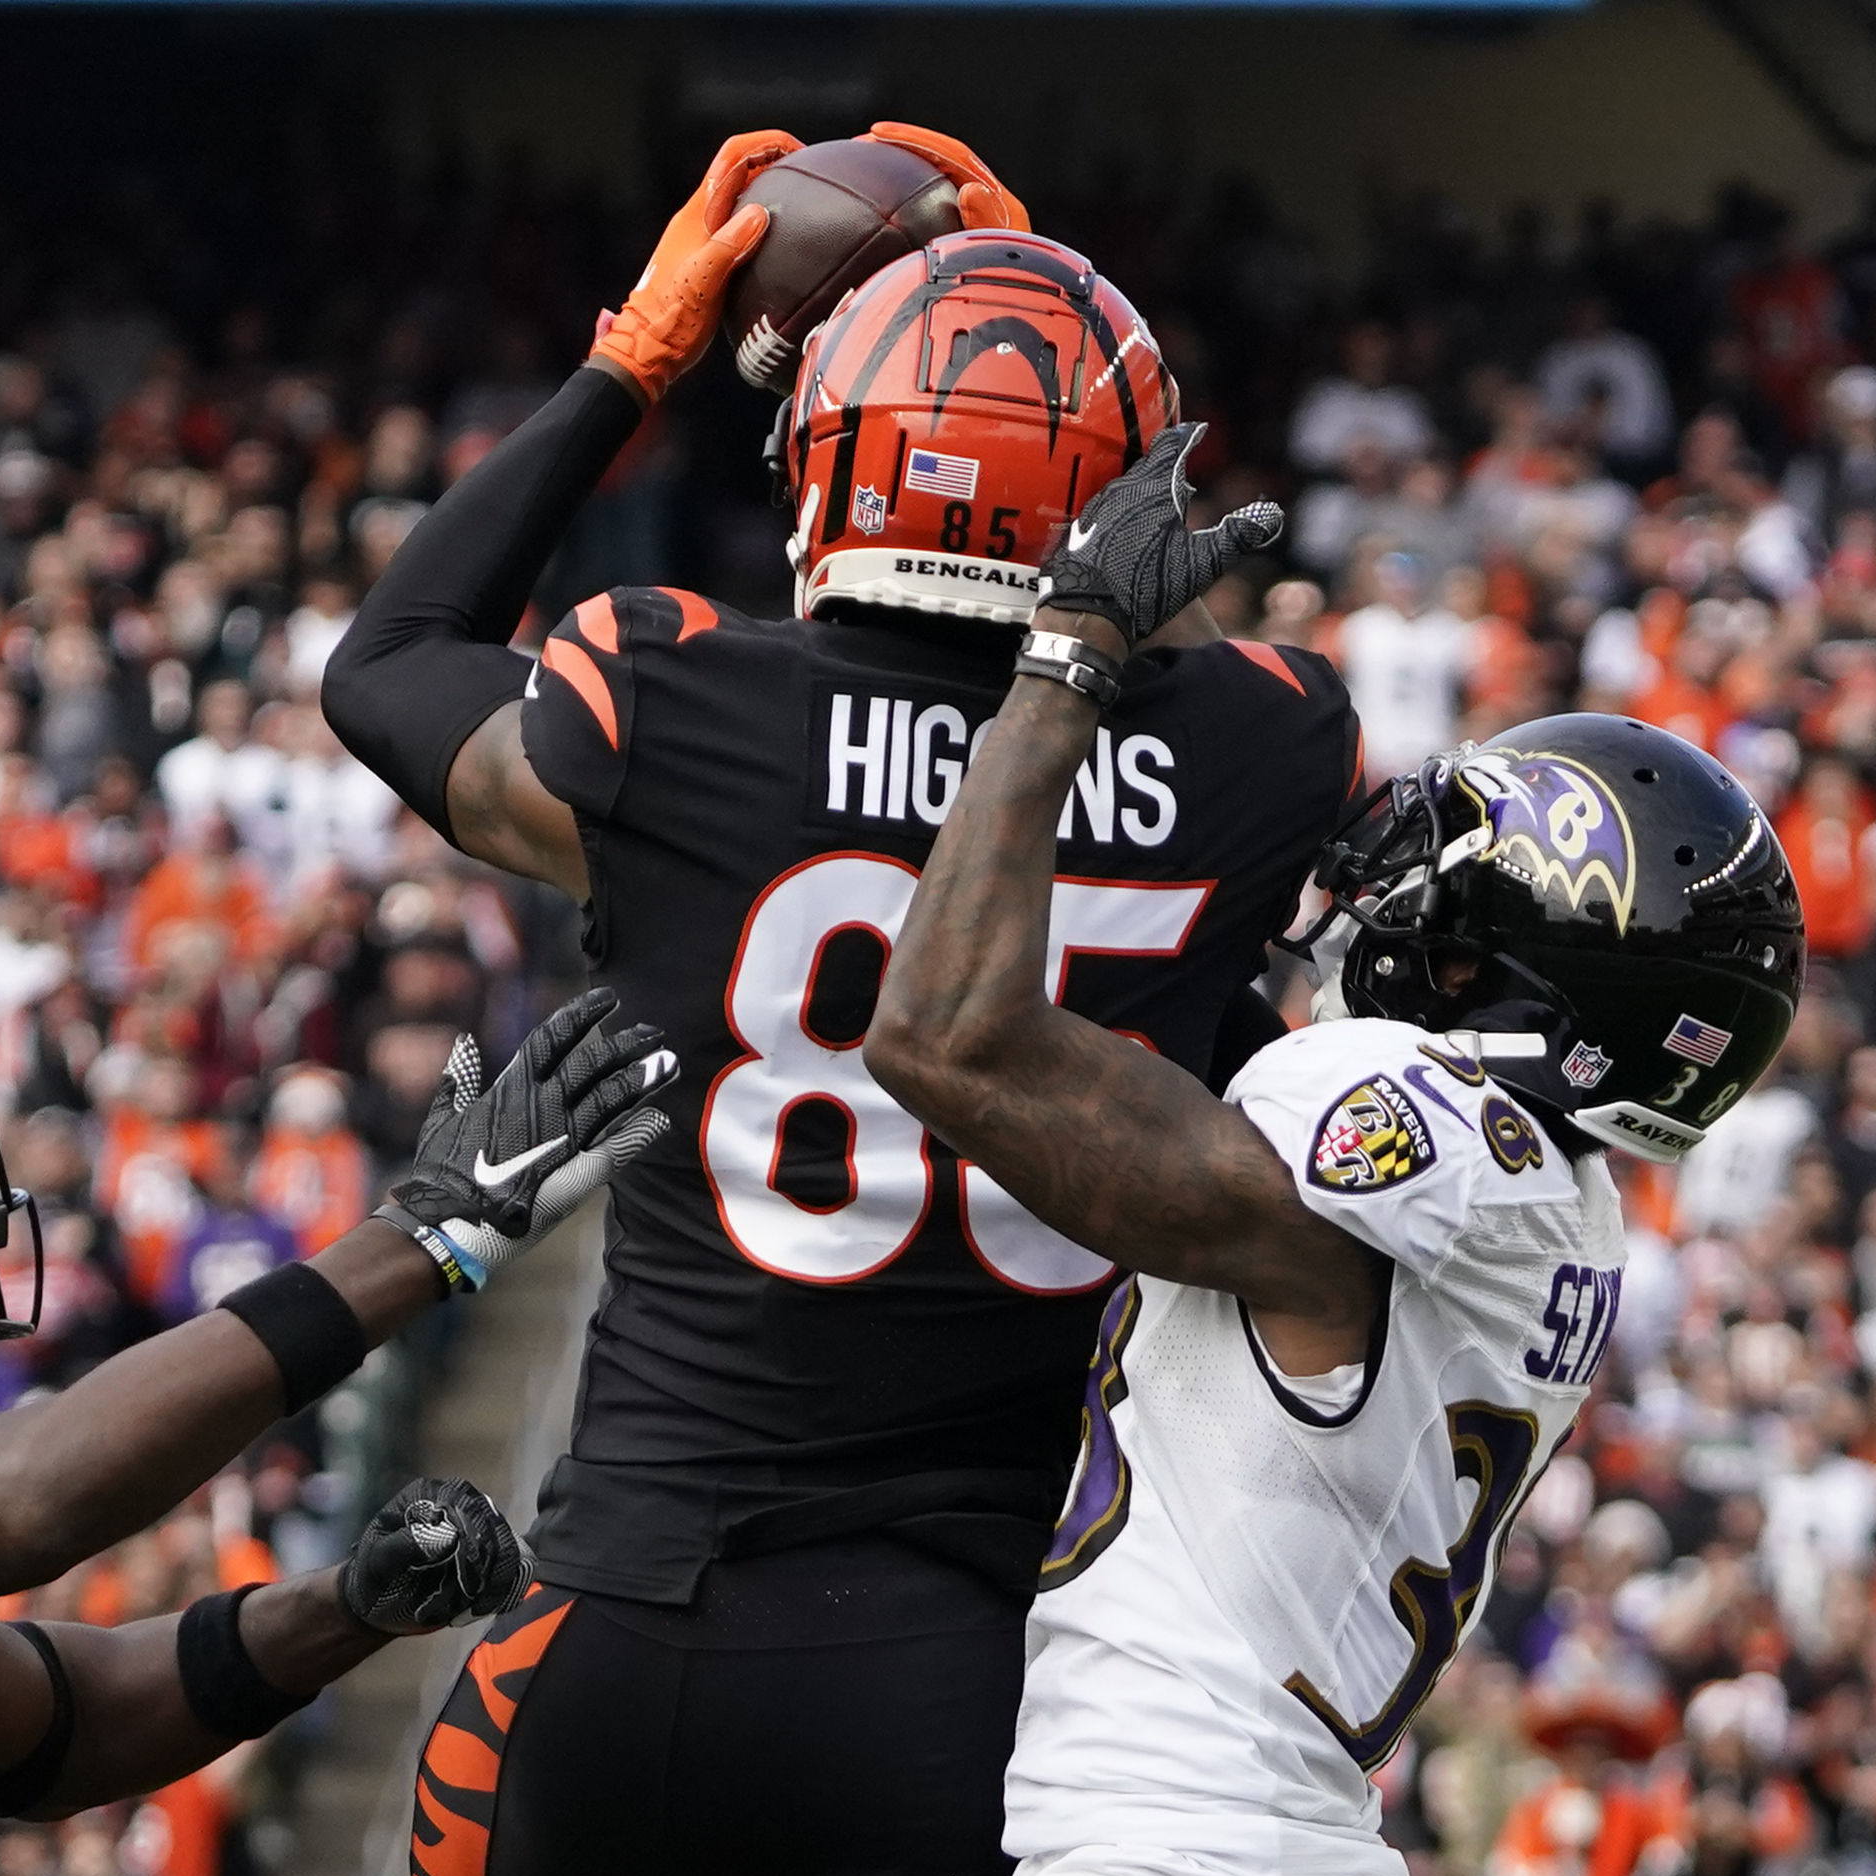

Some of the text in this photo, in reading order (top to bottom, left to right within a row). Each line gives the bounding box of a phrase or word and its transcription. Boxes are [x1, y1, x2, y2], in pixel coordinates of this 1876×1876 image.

[855, 507, 881, 534] NFL
[940, 500, 1021, 560] 85
[894, 558, 1040, 592] BENGALS
[827, 693, 1178, 848] HIGNS
[1567, 1057, 1598, 1083] NFL
[1654, 1065, 1741, 1121] 38
[1372, 1076, 1431, 1159] RAVENS
[1610, 1111, 1698, 1150] RAVEN
